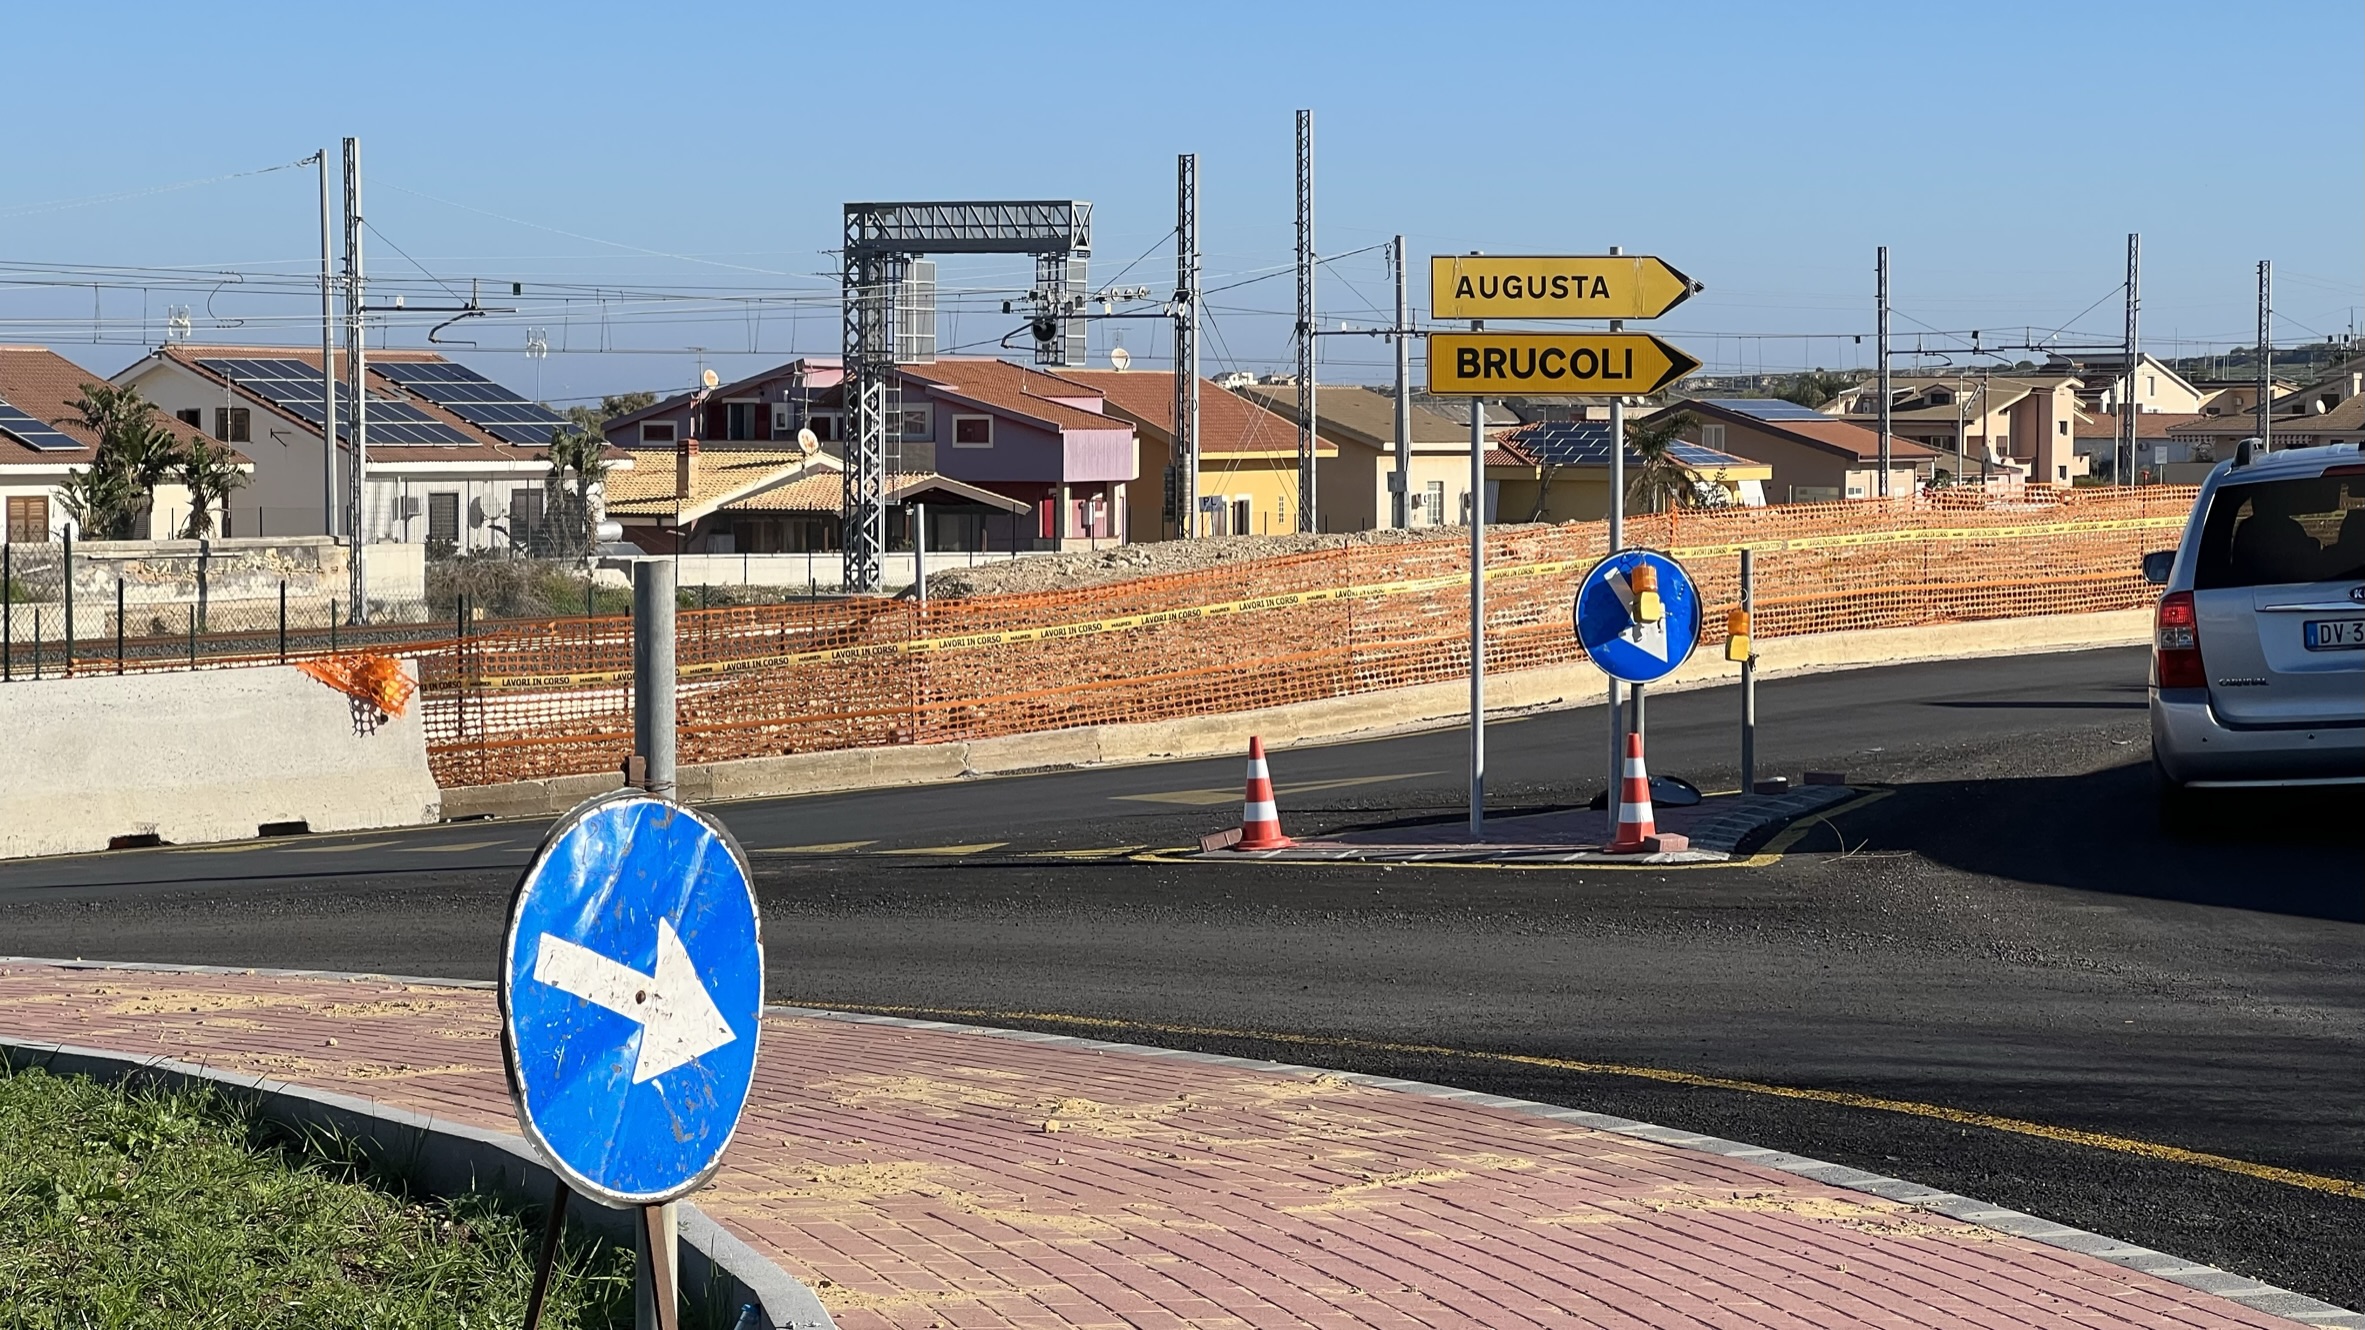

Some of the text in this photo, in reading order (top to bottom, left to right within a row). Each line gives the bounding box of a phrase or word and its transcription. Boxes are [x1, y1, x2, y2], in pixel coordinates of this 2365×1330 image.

[1455, 275, 1611, 299] AUGUSTA
[1456, 347, 1633, 380] BRUCOLI
[2354, 589, 2365, 598] K
[1239, 596, 1299, 611] LAVORI IN CORSO
[1141, 609, 1201, 625] LAVORI IN CORSO
[1040, 623, 1103, 638] LAVORI IN CORSO
[939, 635, 1001, 649] LAVORI IN CORSO
[831, 645, 898, 659] LAVORI IN CORSO
[722, 657, 789, 672] LAVORI IN CORSO
[502, 676, 570, 687] LAVORI IN CORSO
[613, 673, 635, 681] LAVO
